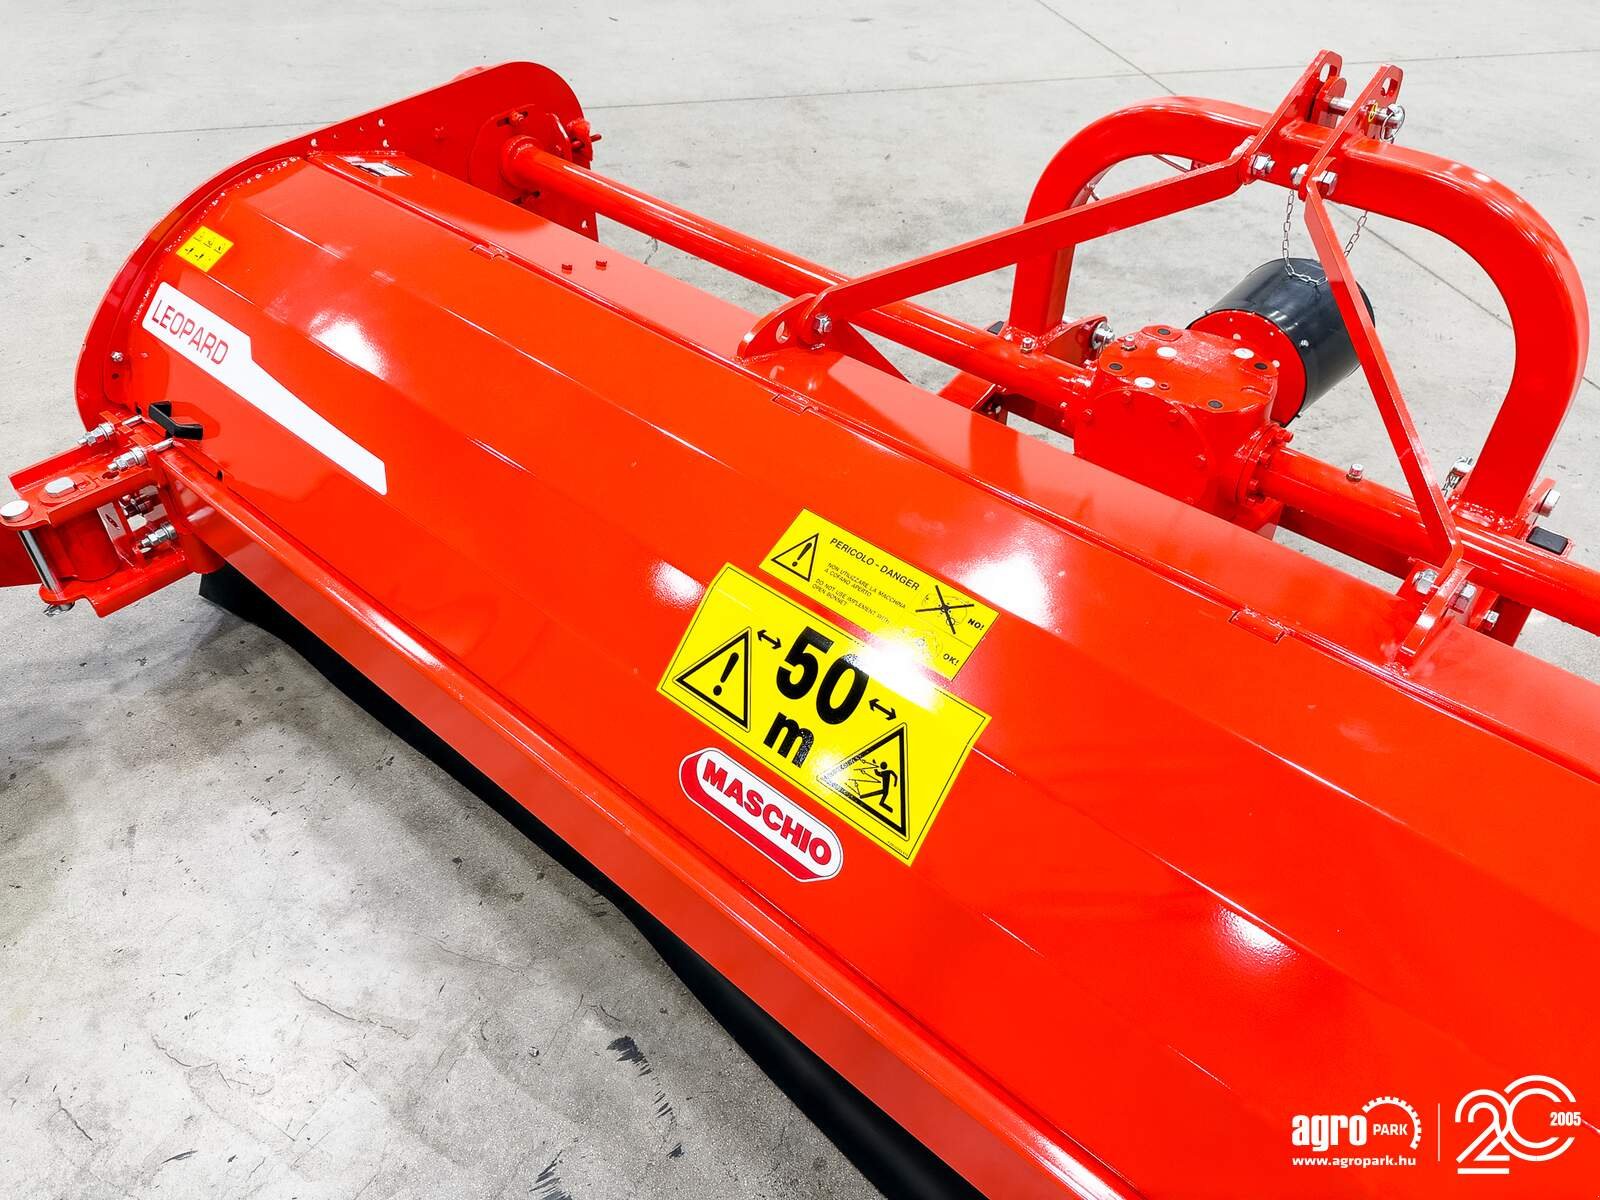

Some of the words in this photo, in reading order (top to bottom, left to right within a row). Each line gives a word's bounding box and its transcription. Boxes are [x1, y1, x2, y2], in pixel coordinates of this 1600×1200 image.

[151, 299, 229, 365] LEOPARD
[828, 562, 839, 572] NON
[840, 569, 869, 588] UTILIZZARE
[869, 585, 877, 593] LA
[878, 590, 906, 609] MACCHINA
[829, 537, 875, 566] PERICOLO
[879, 565, 920, 591] DANGER
[829, 570, 851, 586] COFANO
[851, 581, 872, 597] APERTO
[811, 583, 826, 595] OPEN
[826, 592, 848, 607] BONNET
[815, 578, 824, 586] DO
[825, 583, 836, 592] NOT
[835, 589, 847, 599] USE
[847, 596, 876, 615] IMPLEMENT
[967, 617, 985, 631] NO!
[775, 625, 870, 725] 50
[942, 652, 960, 666] OK!
[763, 711, 815, 768] m
[702, 758, 832, 867] MASCHIO
